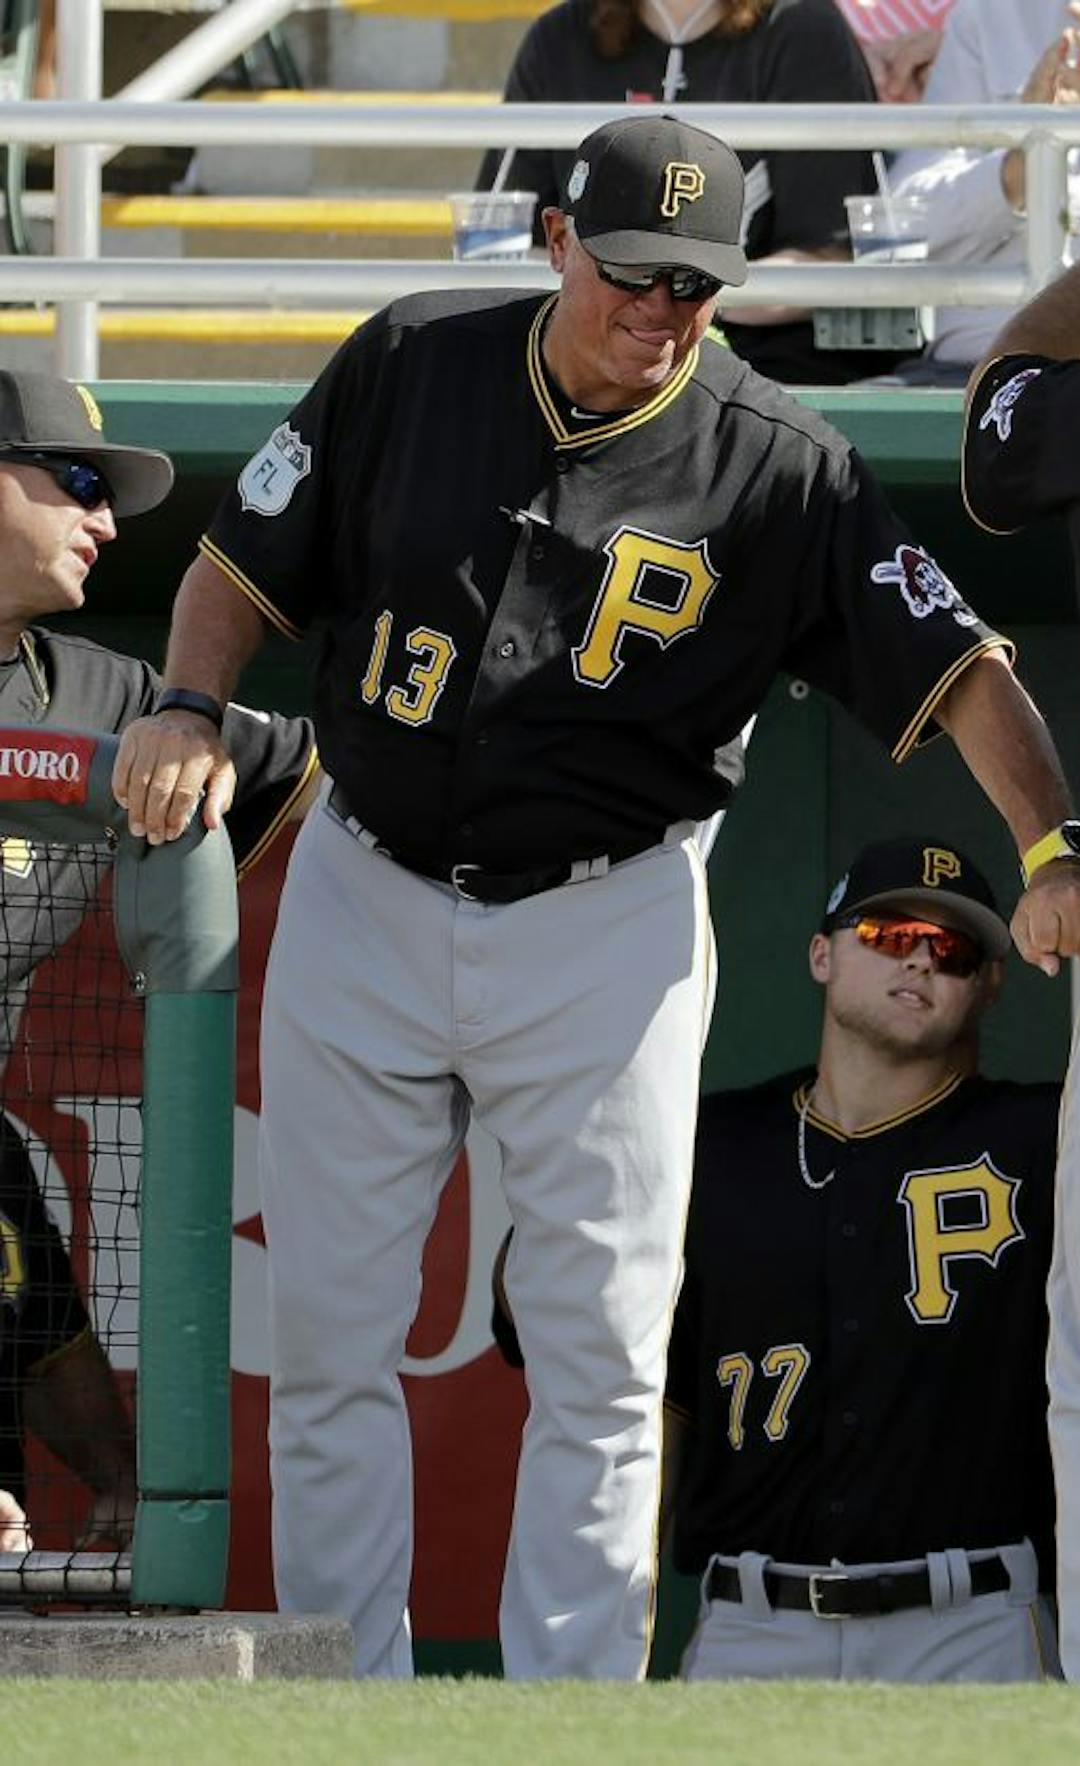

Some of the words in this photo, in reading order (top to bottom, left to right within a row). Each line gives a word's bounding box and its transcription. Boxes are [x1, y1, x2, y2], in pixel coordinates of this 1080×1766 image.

[661, 162, 705, 217] P
[571, 525, 721, 689] P
[361, 609, 457, 727] 13
[0, 748, 80, 782] TORO
[923, 847, 961, 887] P
[896, 1151, 1026, 1324] P
[717, 1343, 811, 1450] 77
